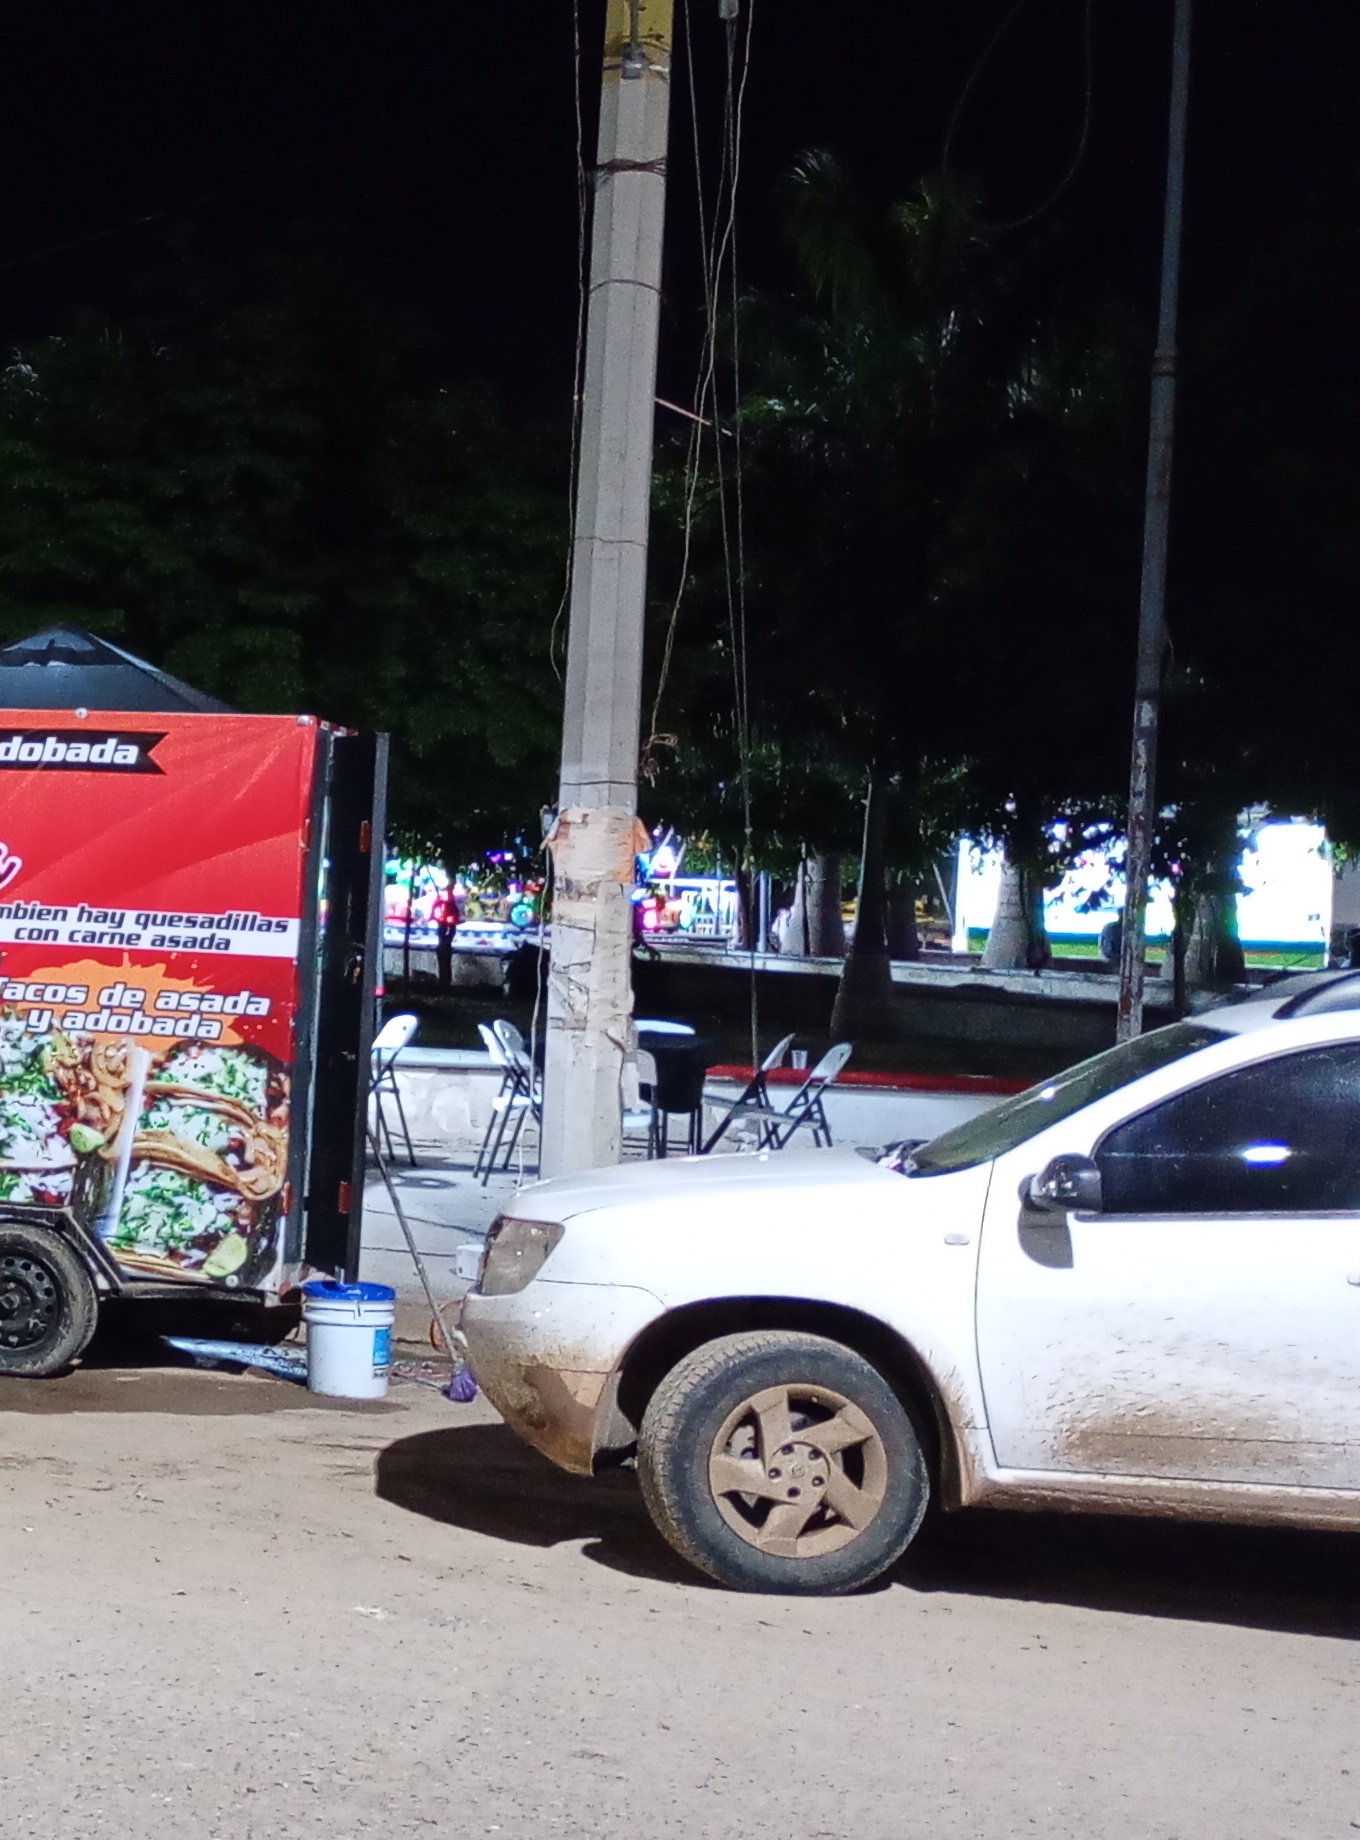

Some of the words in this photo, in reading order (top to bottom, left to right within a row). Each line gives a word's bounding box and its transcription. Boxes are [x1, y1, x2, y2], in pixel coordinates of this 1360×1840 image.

[77, 905, 125, 929] hay
[135, 911, 289, 934] quesadillas
[14, 926, 59, 941] con
[68, 930, 141, 946] carne
[151, 933, 231, 951] asada
[99, 982, 146, 1009] de
[156, 991, 271, 1017] asada
[26, 1008, 53, 1034] y
[60, 1008, 223, 1040] adobada
